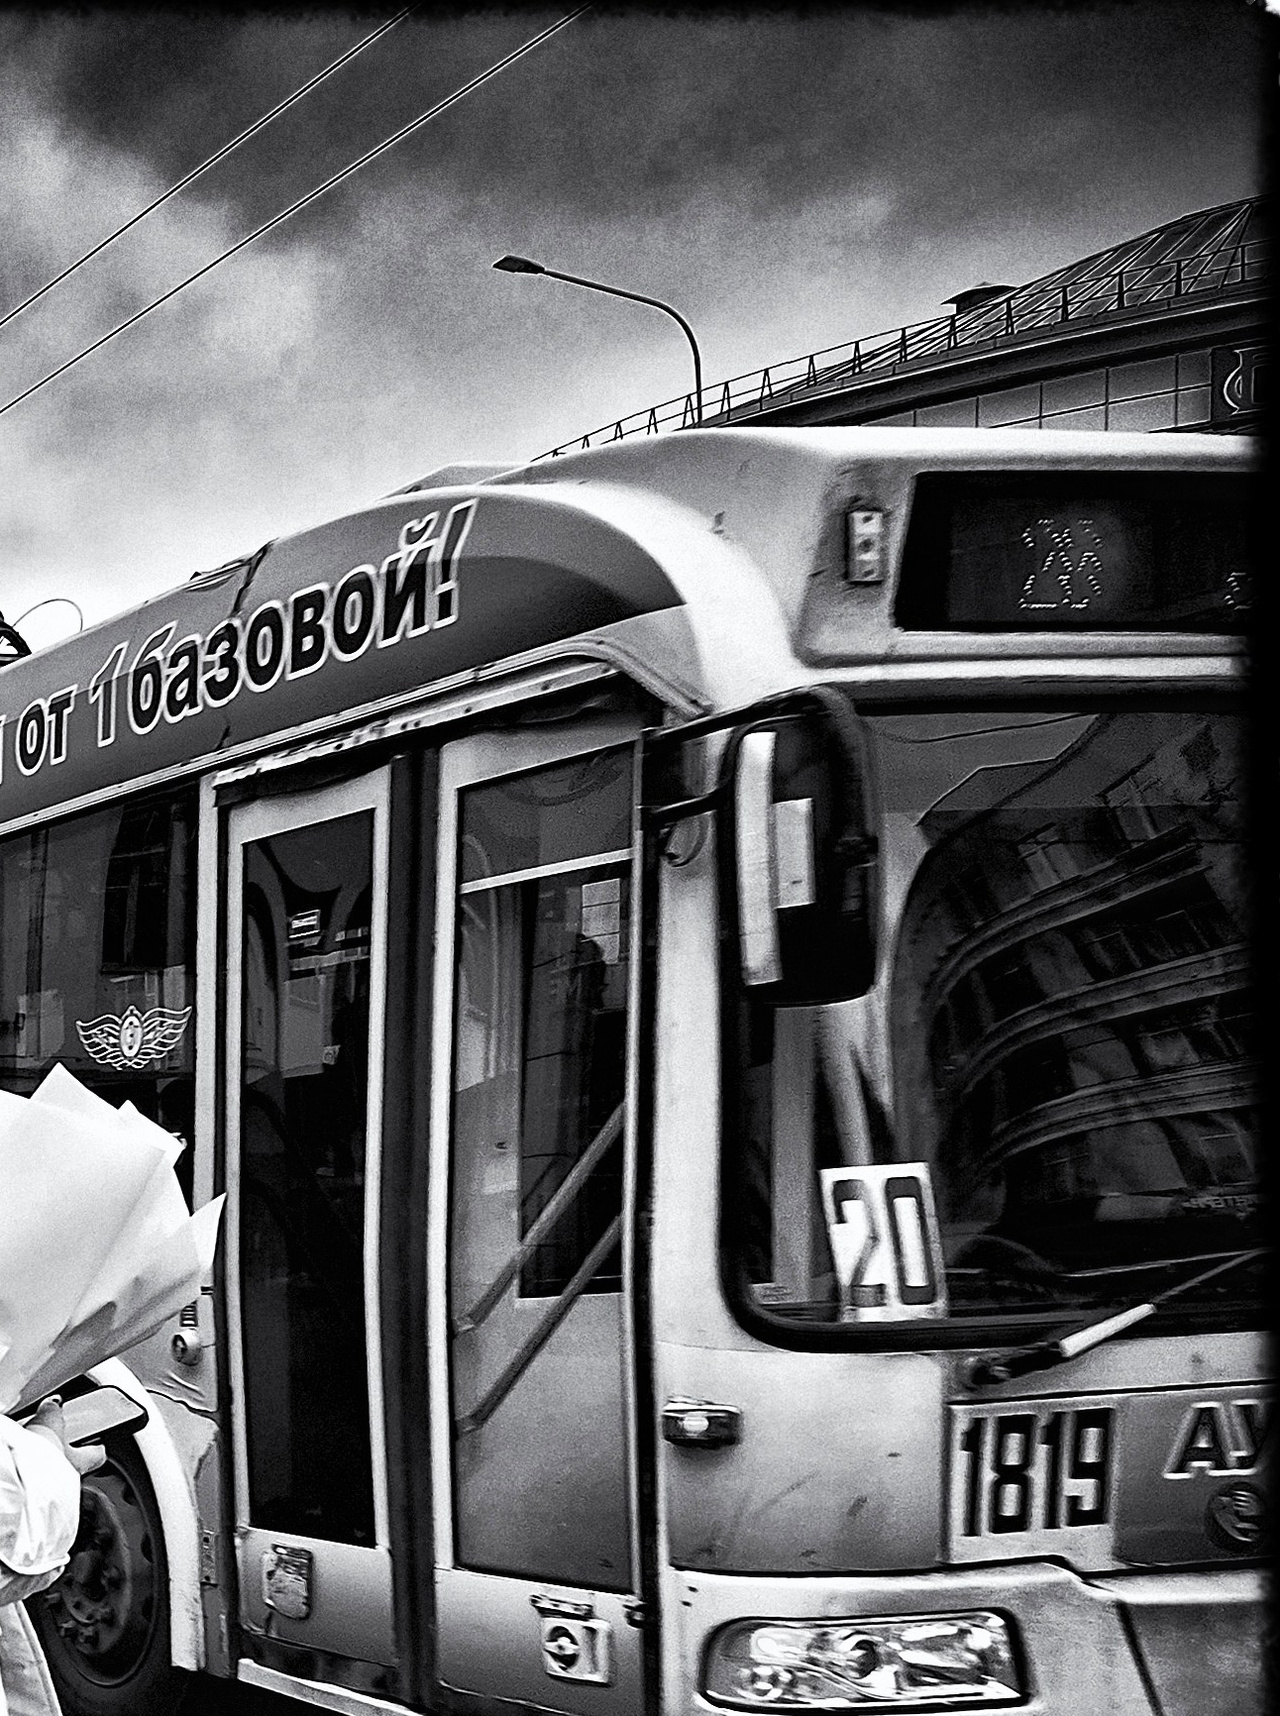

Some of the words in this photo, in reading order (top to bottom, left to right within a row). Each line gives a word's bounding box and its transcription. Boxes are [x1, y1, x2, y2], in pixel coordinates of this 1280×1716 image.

[16, 686, 77, 775] от
[832, 1177, 937, 1307] 20
[960, 1407, 1114, 1537] 1819
